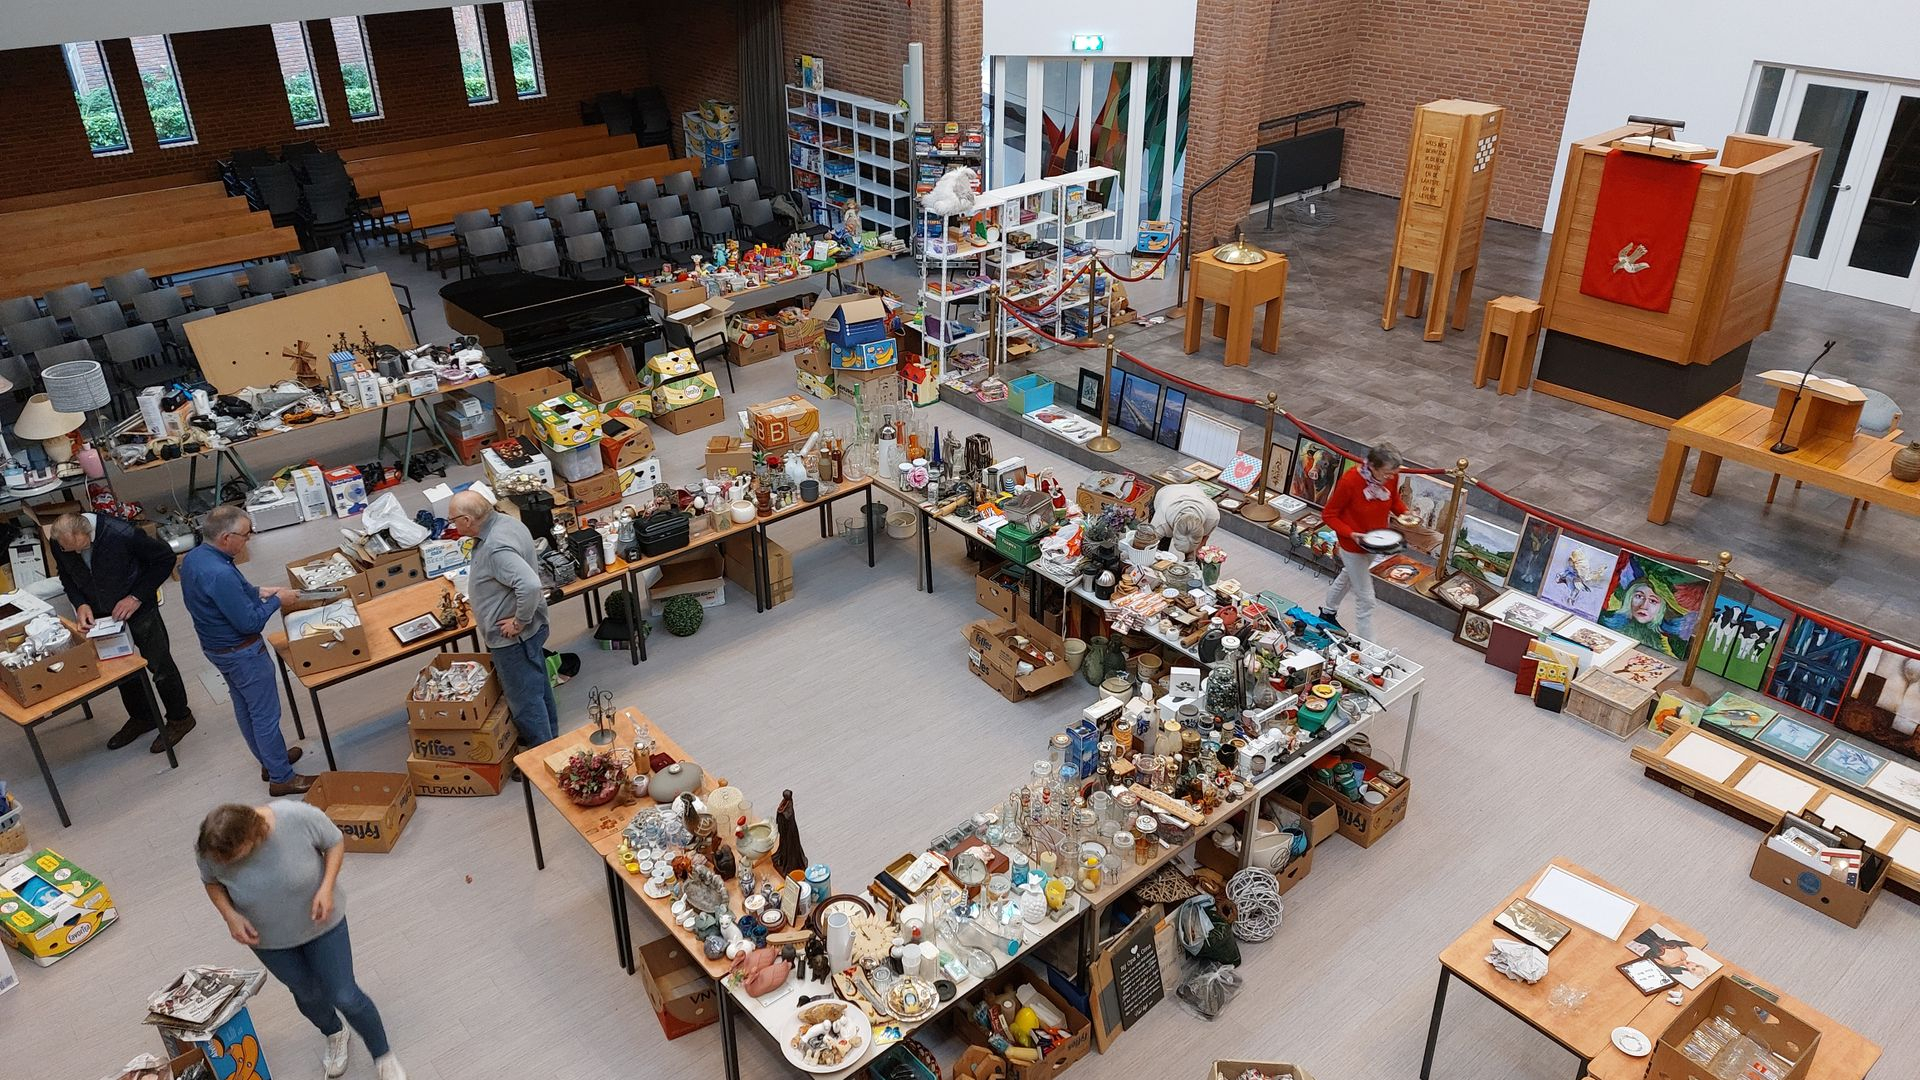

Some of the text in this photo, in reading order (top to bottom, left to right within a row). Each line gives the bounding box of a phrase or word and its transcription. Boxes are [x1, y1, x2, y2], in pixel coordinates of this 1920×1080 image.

[769, 422, 785, 442] B
[414, 739, 456, 757] Fyffes
[418, 785, 477, 795] TURBANA
